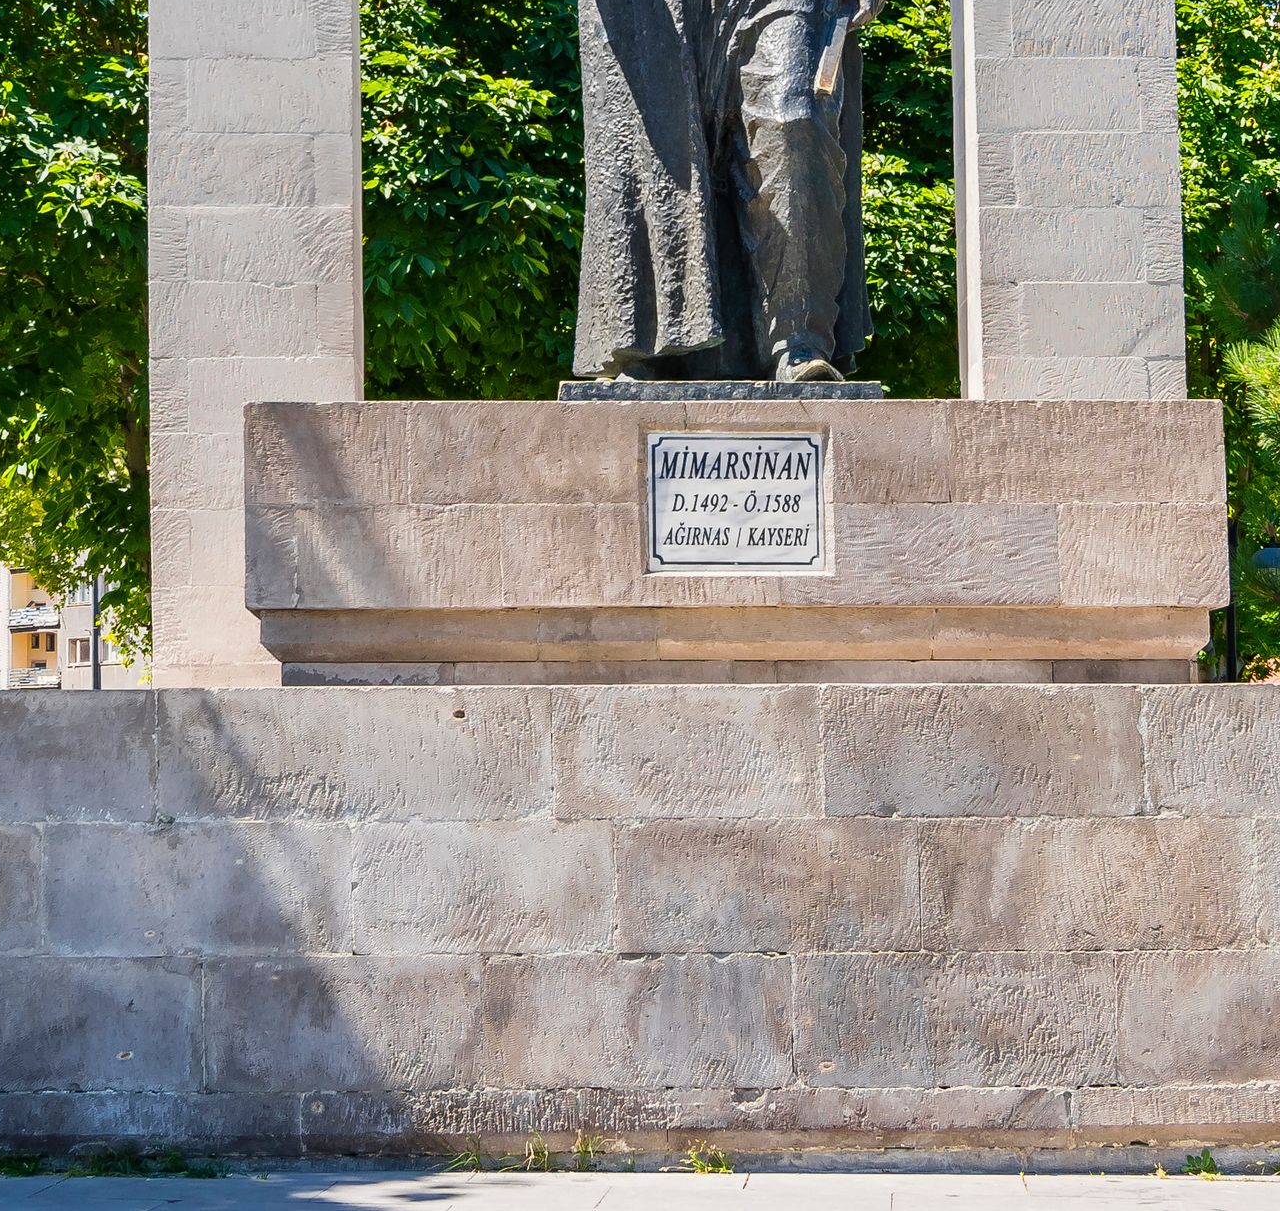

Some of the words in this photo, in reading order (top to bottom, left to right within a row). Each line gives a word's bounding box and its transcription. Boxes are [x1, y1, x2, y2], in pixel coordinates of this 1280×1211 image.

[659, 446, 813, 480] MİMARSİNAN
[672, 493, 729, 513] D.1492
[744, 490, 801, 513] Ö.1588
[663, 522, 730, 546] AĞIRNAS
[736, 527, 742, 548] /
[747, 523, 810, 547] KAYSERİ
